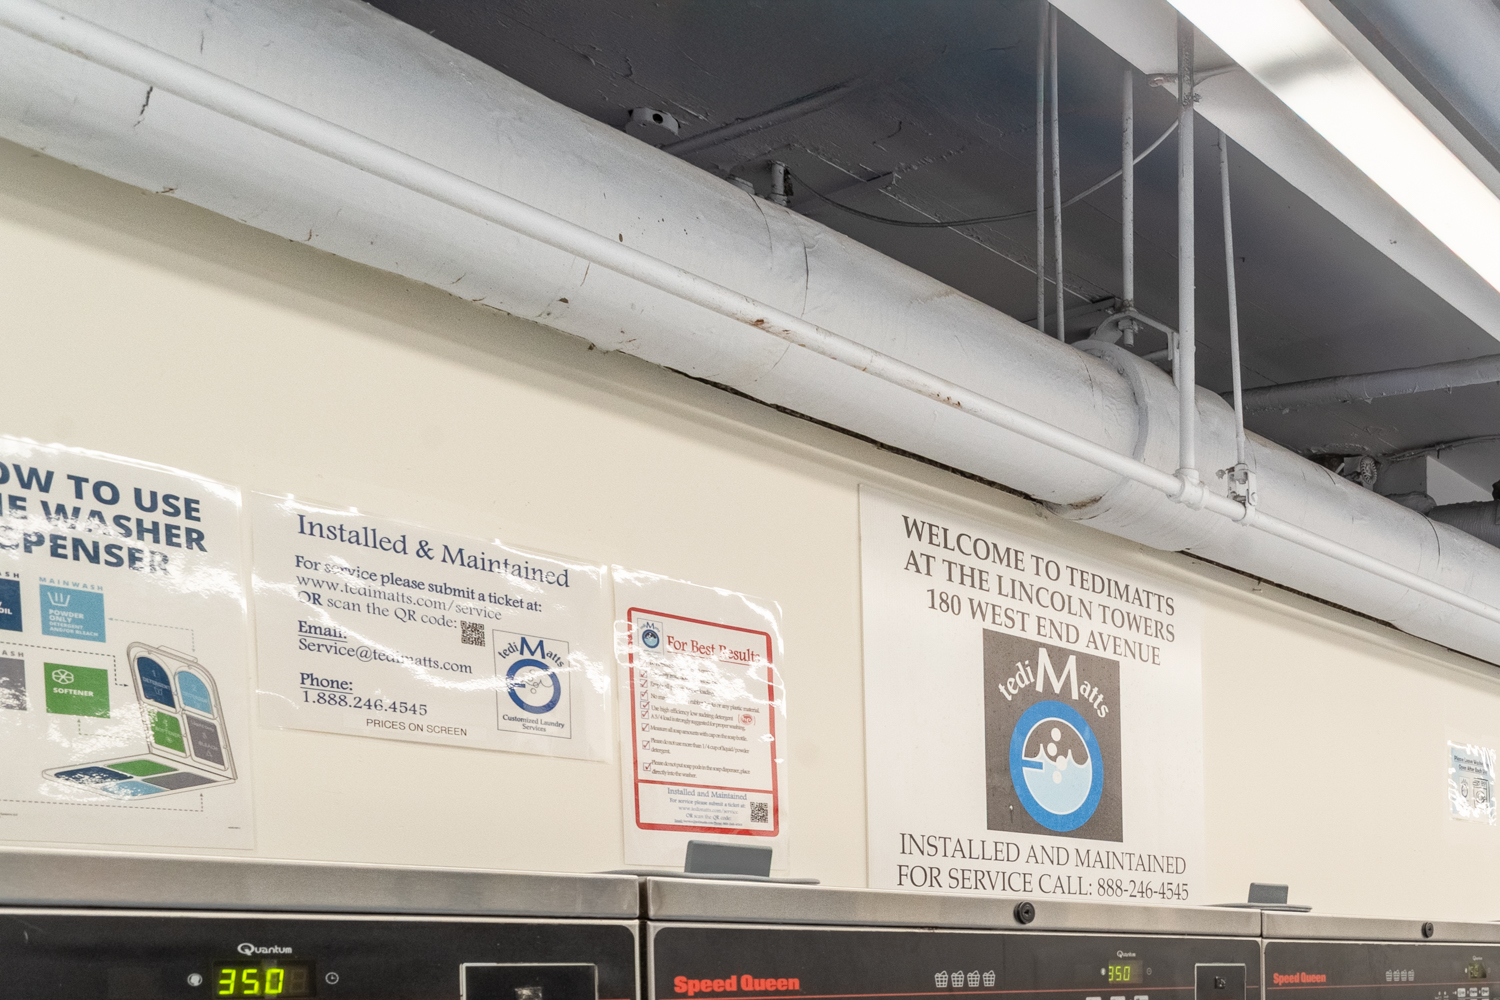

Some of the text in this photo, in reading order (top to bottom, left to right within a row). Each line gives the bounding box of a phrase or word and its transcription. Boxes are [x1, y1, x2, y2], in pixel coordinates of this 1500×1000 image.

[67, 474, 120, 506] TO
[134, 487, 201, 522] USE
[40, 500, 208, 553] WASHER
[297, 514, 570, 588] Installed & Maintained
[901, 514, 1175, 616] WELCOME TO TEDIMATTS
[39, 576, 104, 591] MAINWASH
[295, 555, 542, 612] For service please submit a ticket at:
[904, 549, 1176, 643] AT THE LINCOLN TOWERS
[49, 609, 84, 620] POWDER
[298, 590, 457, 628] OR scan the QR code:
[49, 615, 72, 624] ONLY
[49, 621, 83, 630] DETERGENT
[927, 588, 1161, 666] 180 WEST END AVENUE
[75, 629, 99, 637] BLEACH
[298, 620, 347, 640] Email:
[667, 635, 688, 651] For
[690, 640, 716, 656] Best
[300, 672, 353, 691] Phone:
[53, 687, 94, 697] SOFTENER
[302, 690, 428, 716] 1.888.246.4545
[366, 718, 468, 737] PRICES ON SCREEN
[502, 714, 565, 729] Customized Laundry
[522, 723, 546, 732] Services
[667, 787, 747, 800] Installed and Maintained
[899, 832, 1187, 875] INSTALLED AND MAINTAINED
[896, 863, 1189, 901] FOR SERVICE CALL: 888-246-4545
[237, 942, 292, 956] Quantum
[218, 968, 285, 995] 350
[1108, 965, 1131, 982] 350
[1273, 972, 1327, 986] Speed Queen
[674, 974, 800, 996] Speed Queen
